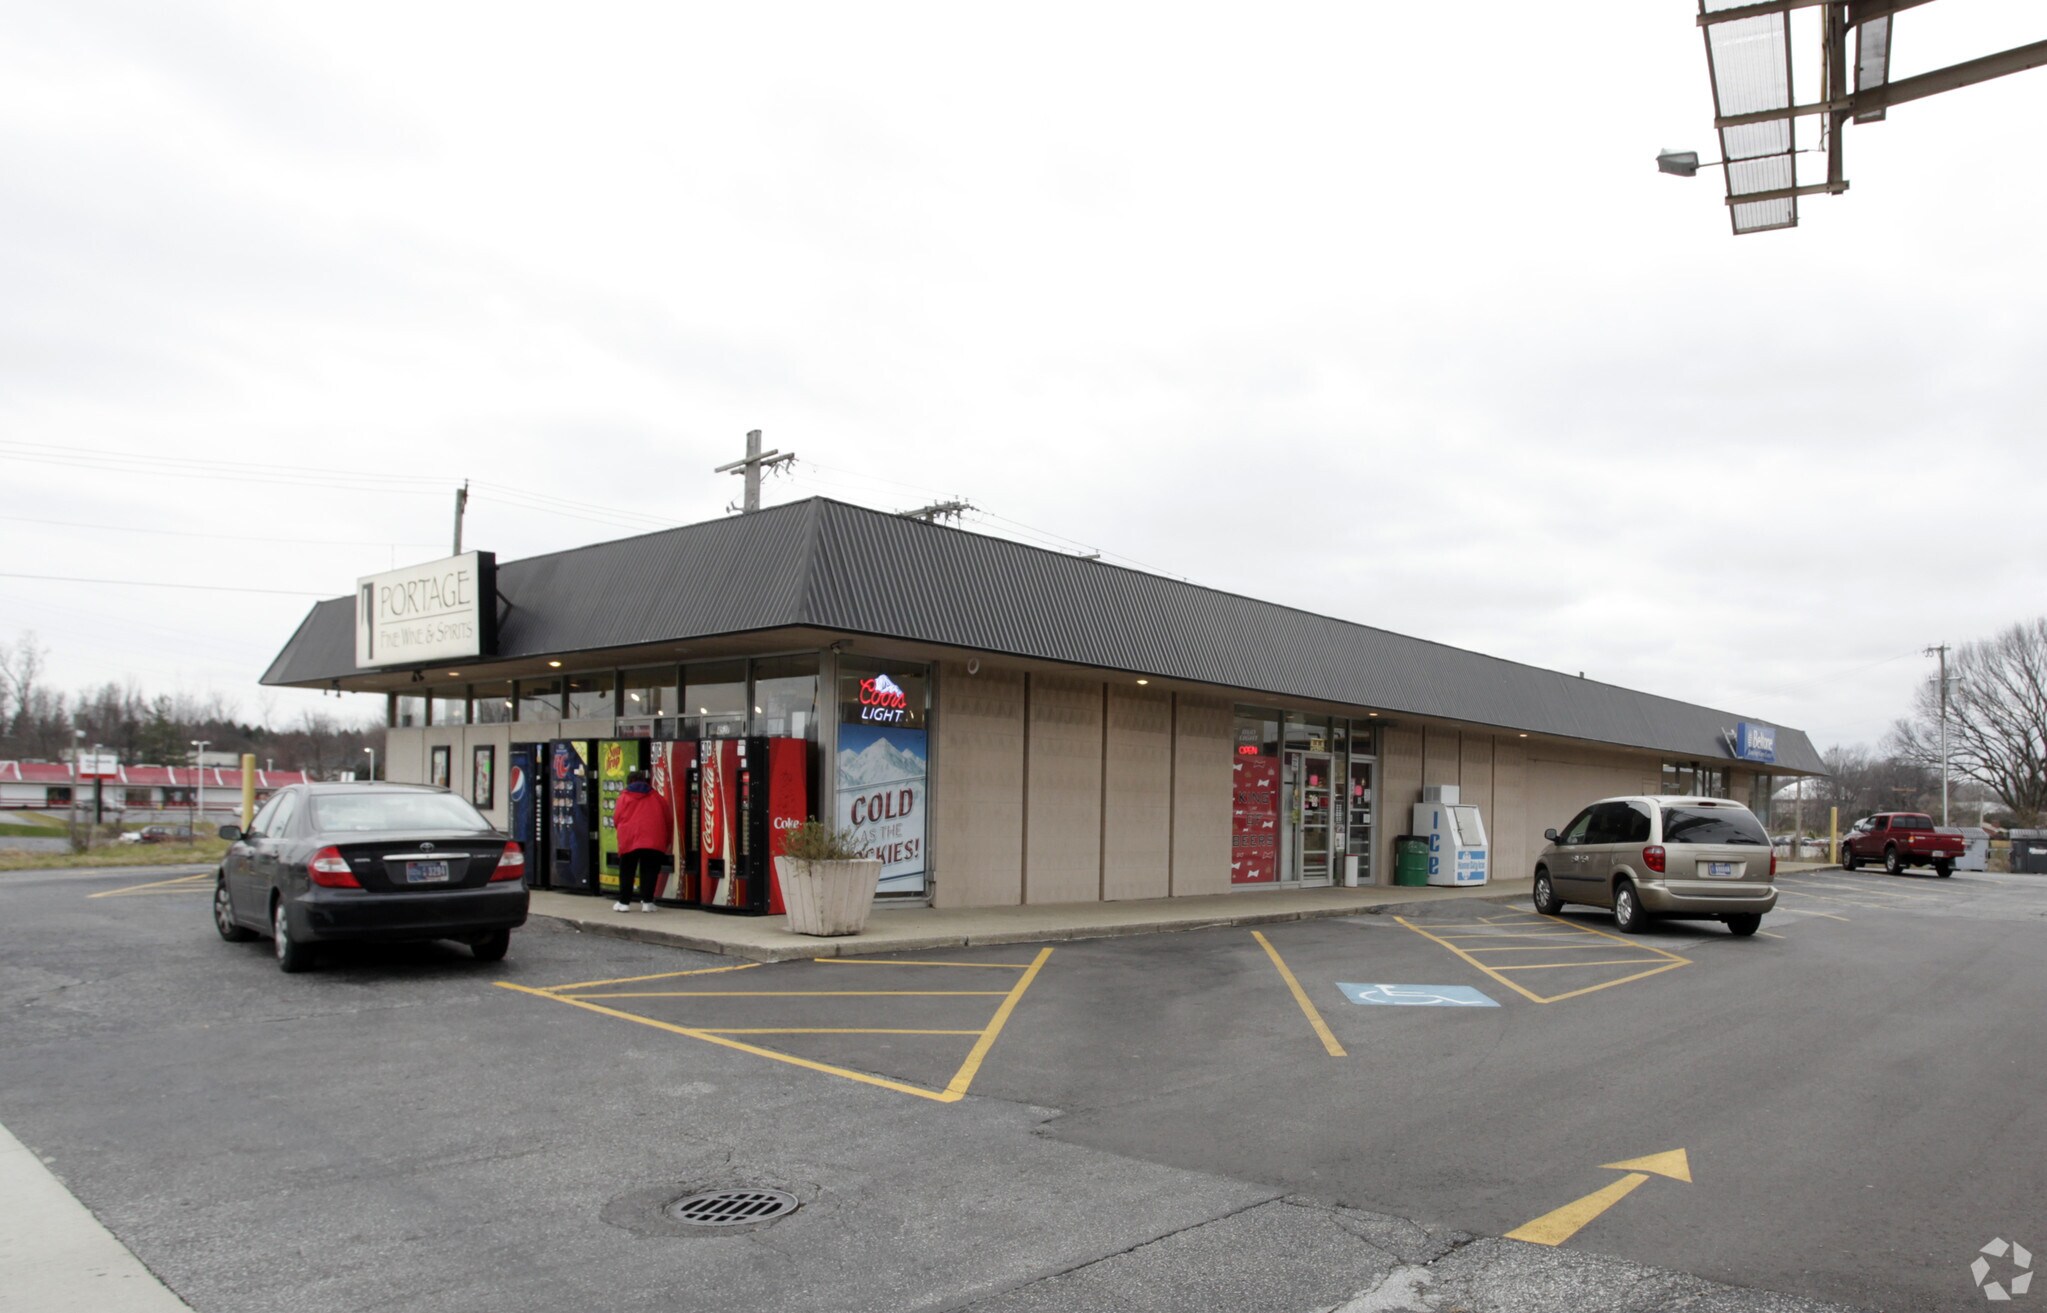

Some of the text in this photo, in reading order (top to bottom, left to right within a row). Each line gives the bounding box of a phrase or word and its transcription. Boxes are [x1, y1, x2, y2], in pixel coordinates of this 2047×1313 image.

[380, 570, 471, 619] PORTAGE
[425, 623, 435, 644] &
[859, 678, 907, 709] Coors
[861, 706, 905, 723] LIGHT
[1238, 745, 1259, 755] OPEN
[1752, 729, 1774, 751] Beltone
[850, 787, 914, 826] COLD
[1239, 791, 1270, 805] KING
[702, 766, 715, 855] Coca-Cola
[1247, 813, 1263, 826] OF
[773, 816, 800, 830] Coke
[860, 822, 904, 843] AS THE
[853, 838, 920, 865] CKIES!
[1232, 834, 1273, 848] BEERS
